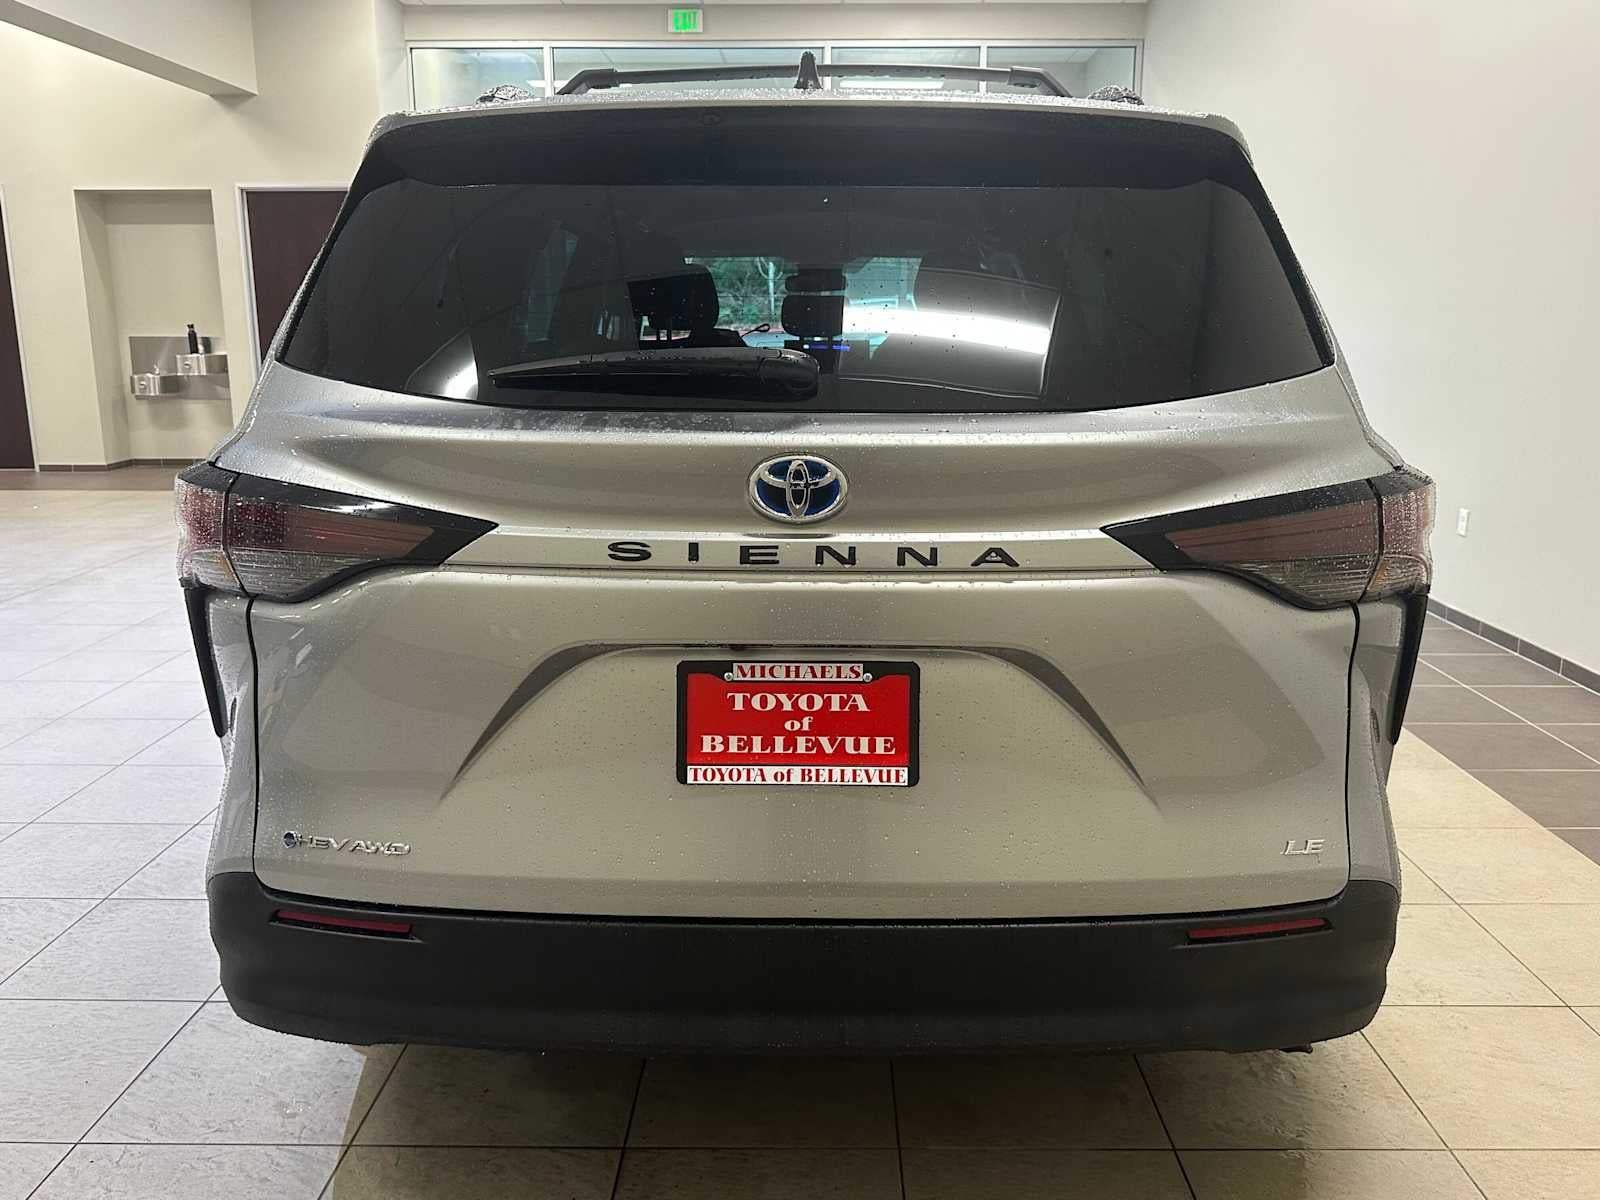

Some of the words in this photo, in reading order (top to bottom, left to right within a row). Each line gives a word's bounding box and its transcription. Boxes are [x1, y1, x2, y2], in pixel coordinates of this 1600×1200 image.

[607, 540, 1020, 568] SIENNA
[736, 664, 862, 679] MICHAELS
[727, 692, 870, 712] TOYOTA
[784, 716, 813, 731] of
[701, 735, 896, 755] BELLEVUE
[689, 767, 767, 782] TOYOTA
[773, 767, 795, 783] of
[800, 767, 907, 784] BELLEVUE
[1280, 839, 1325, 856] LE
